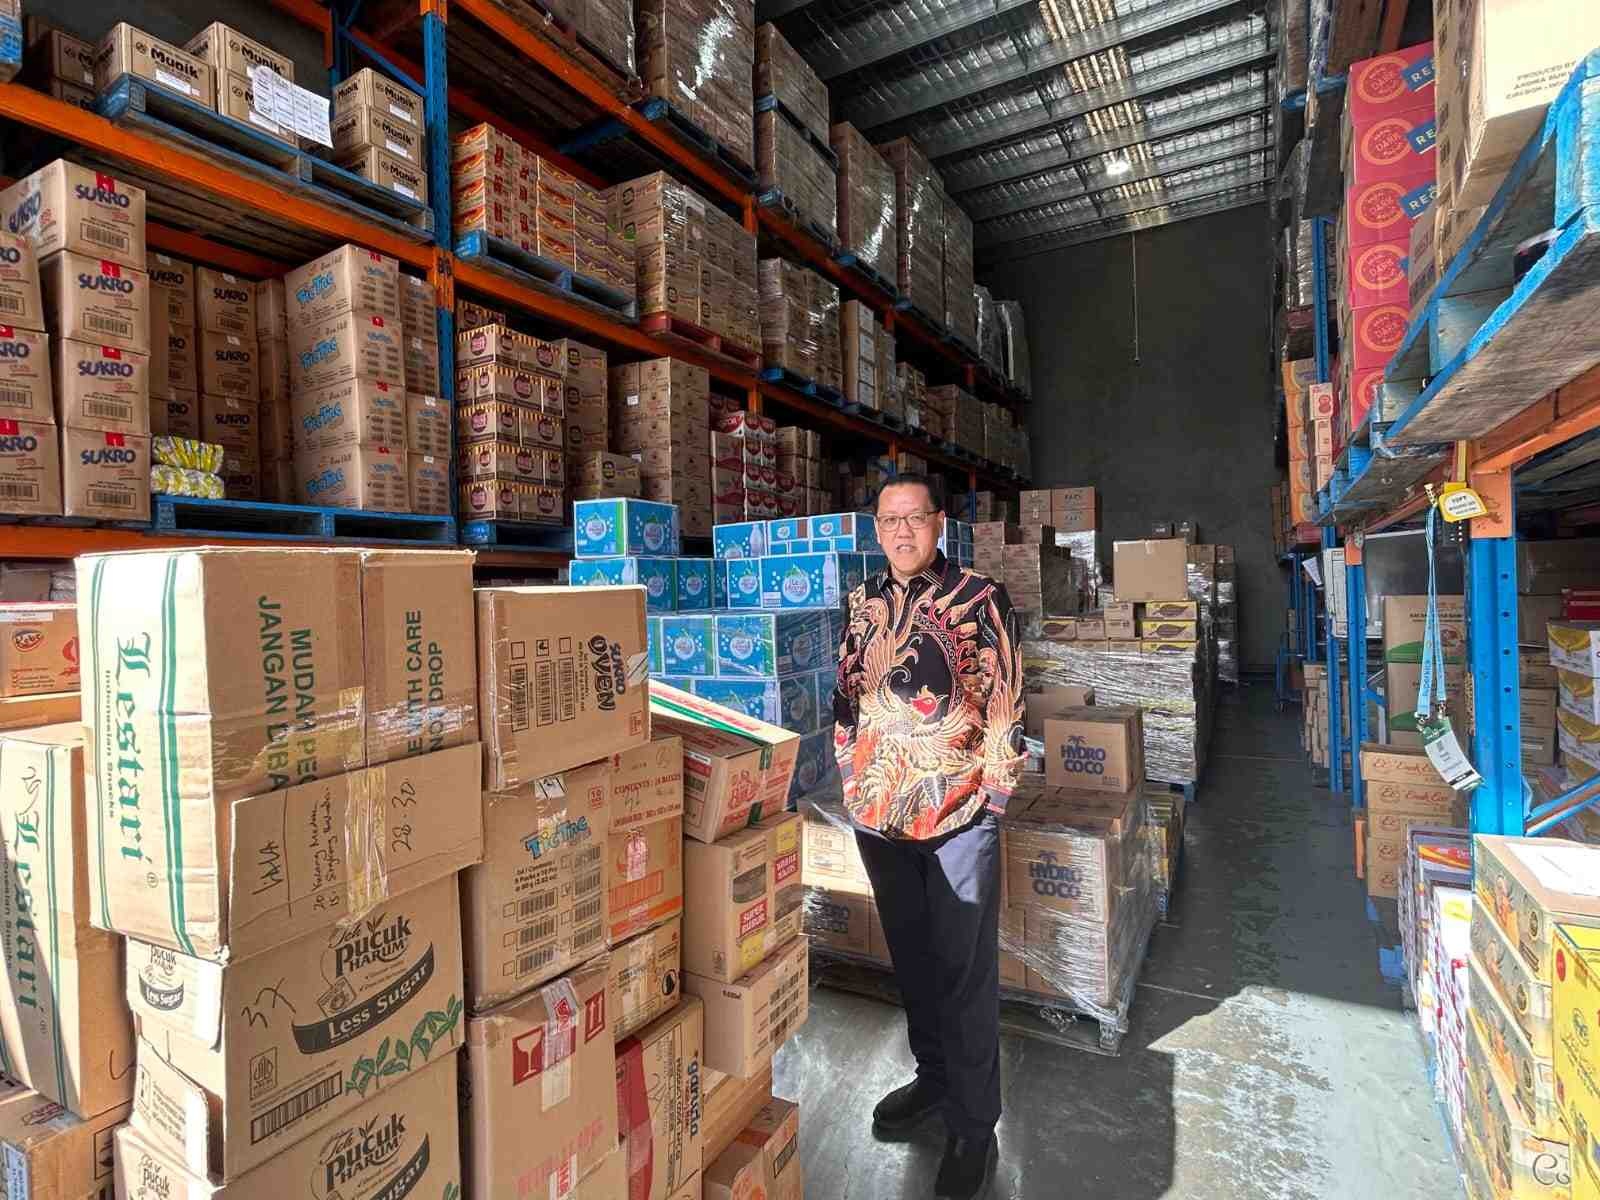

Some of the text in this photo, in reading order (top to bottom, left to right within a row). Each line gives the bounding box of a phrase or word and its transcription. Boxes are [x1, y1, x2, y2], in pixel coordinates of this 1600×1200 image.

[151, 47, 199, 80] Munik
[384, 84, 425, 110] Munik
[382, 121, 423, 145] Munik
[75, 184, 130, 208] SUKRO
[78, 273, 134, 294] SUKRO
[213, 287, 249, 303] SUKRO
[78, 360, 134, 377] SUKRO
[215, 350, 250, 364] SUKRO
[80, 450, 136, 465] SUKRO
[406, 610, 423, 672] CARE
[257, 595, 288, 716] JANGAN
[428, 641, 444, 703] DROP
[116, 631, 153, 865] Lestari
[1061, 744, 1106, 762] HYDRO
[1064, 759, 1104, 775] COCO
[1033, 880, 1081, 898] COCO
[350, 940, 406, 973] HARUM
[328, 962, 428, 1040] Less Sugar
